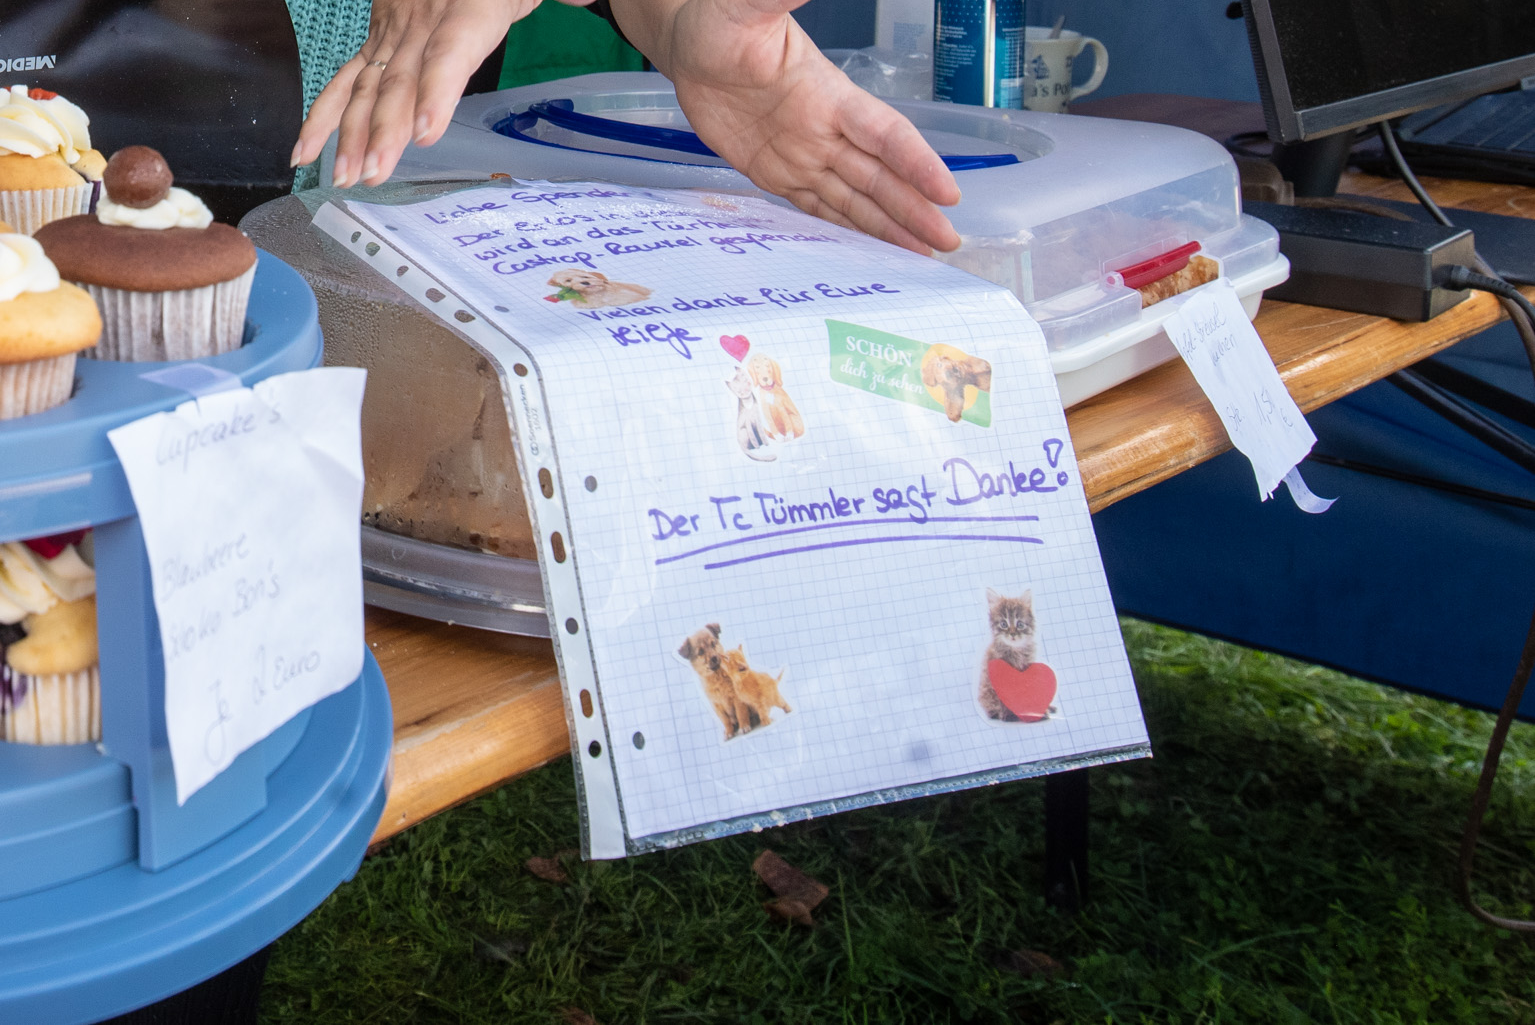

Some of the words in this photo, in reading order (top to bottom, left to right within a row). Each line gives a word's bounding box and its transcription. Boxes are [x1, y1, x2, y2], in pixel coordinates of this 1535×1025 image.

[452, 229, 505, 247] Der
[474, 237, 538, 261] wird
[542, 235, 583, 247] an
[587, 226, 644, 239] das
[579, 296, 672, 322] Vielen
[759, 286, 815, 309] für
[814, 282, 901, 298] Eure
[845, 335, 914, 368] SCHÖN
[840, 357, 869, 380] dich
[871, 371, 887, 391] zu
[648, 508, 700, 541] Der
[753, 486, 865, 526] Tümmler
[875, 474, 937, 524] sagt
[272, 650, 321, 691] Euro
